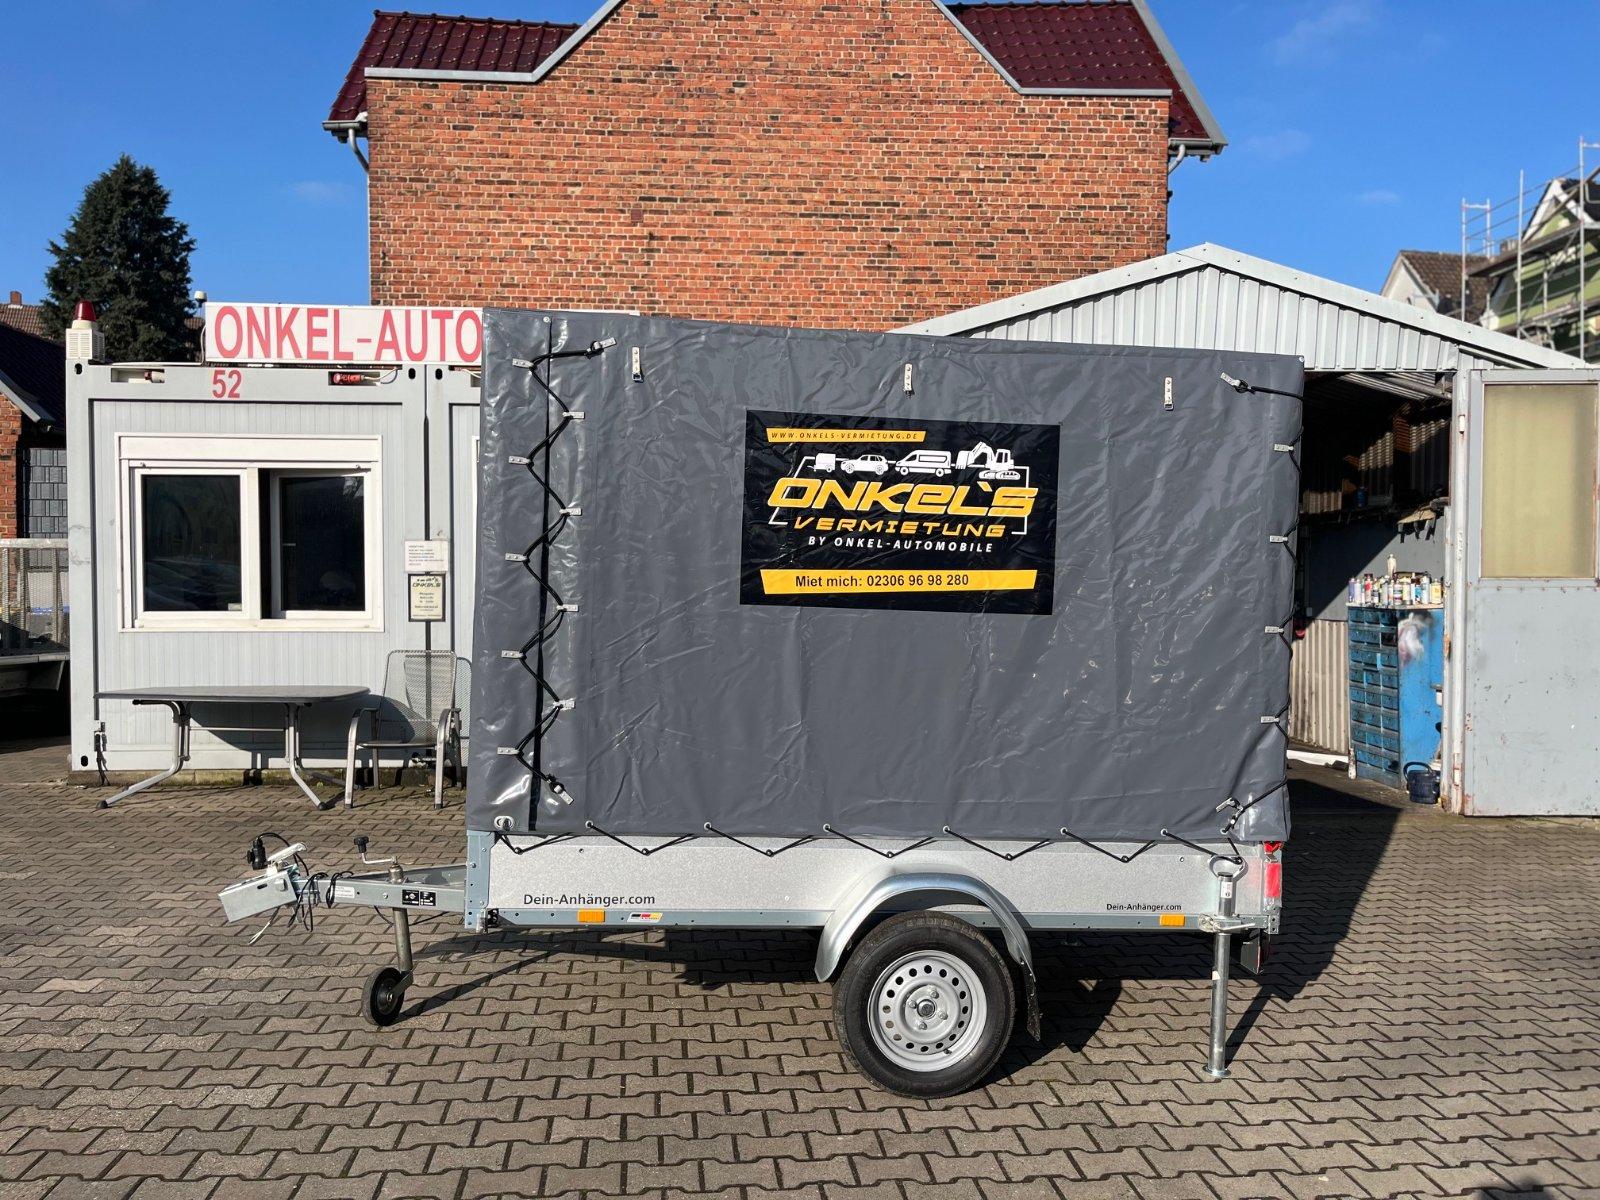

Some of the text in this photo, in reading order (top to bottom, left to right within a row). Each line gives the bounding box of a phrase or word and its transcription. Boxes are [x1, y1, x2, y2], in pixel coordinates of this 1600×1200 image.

[214, 305, 482, 362] ONKEL-AUTO
[212, 369, 242, 399] 52
[771, 431, 918, 440] WWW.ONKELS-VERMIETUNG.DE
[794, 517, 1006, 537] VERMIETUNG
[808, 536, 993, 553] BY ONKEL-AUTOMOBILE
[795, 573, 969, 588] Miet mich: 02306 96 98 280
[523, 893, 655, 907] Dein-Anhänger.com
[1106, 903, 1182, 912] Dein-Anhänger.com
